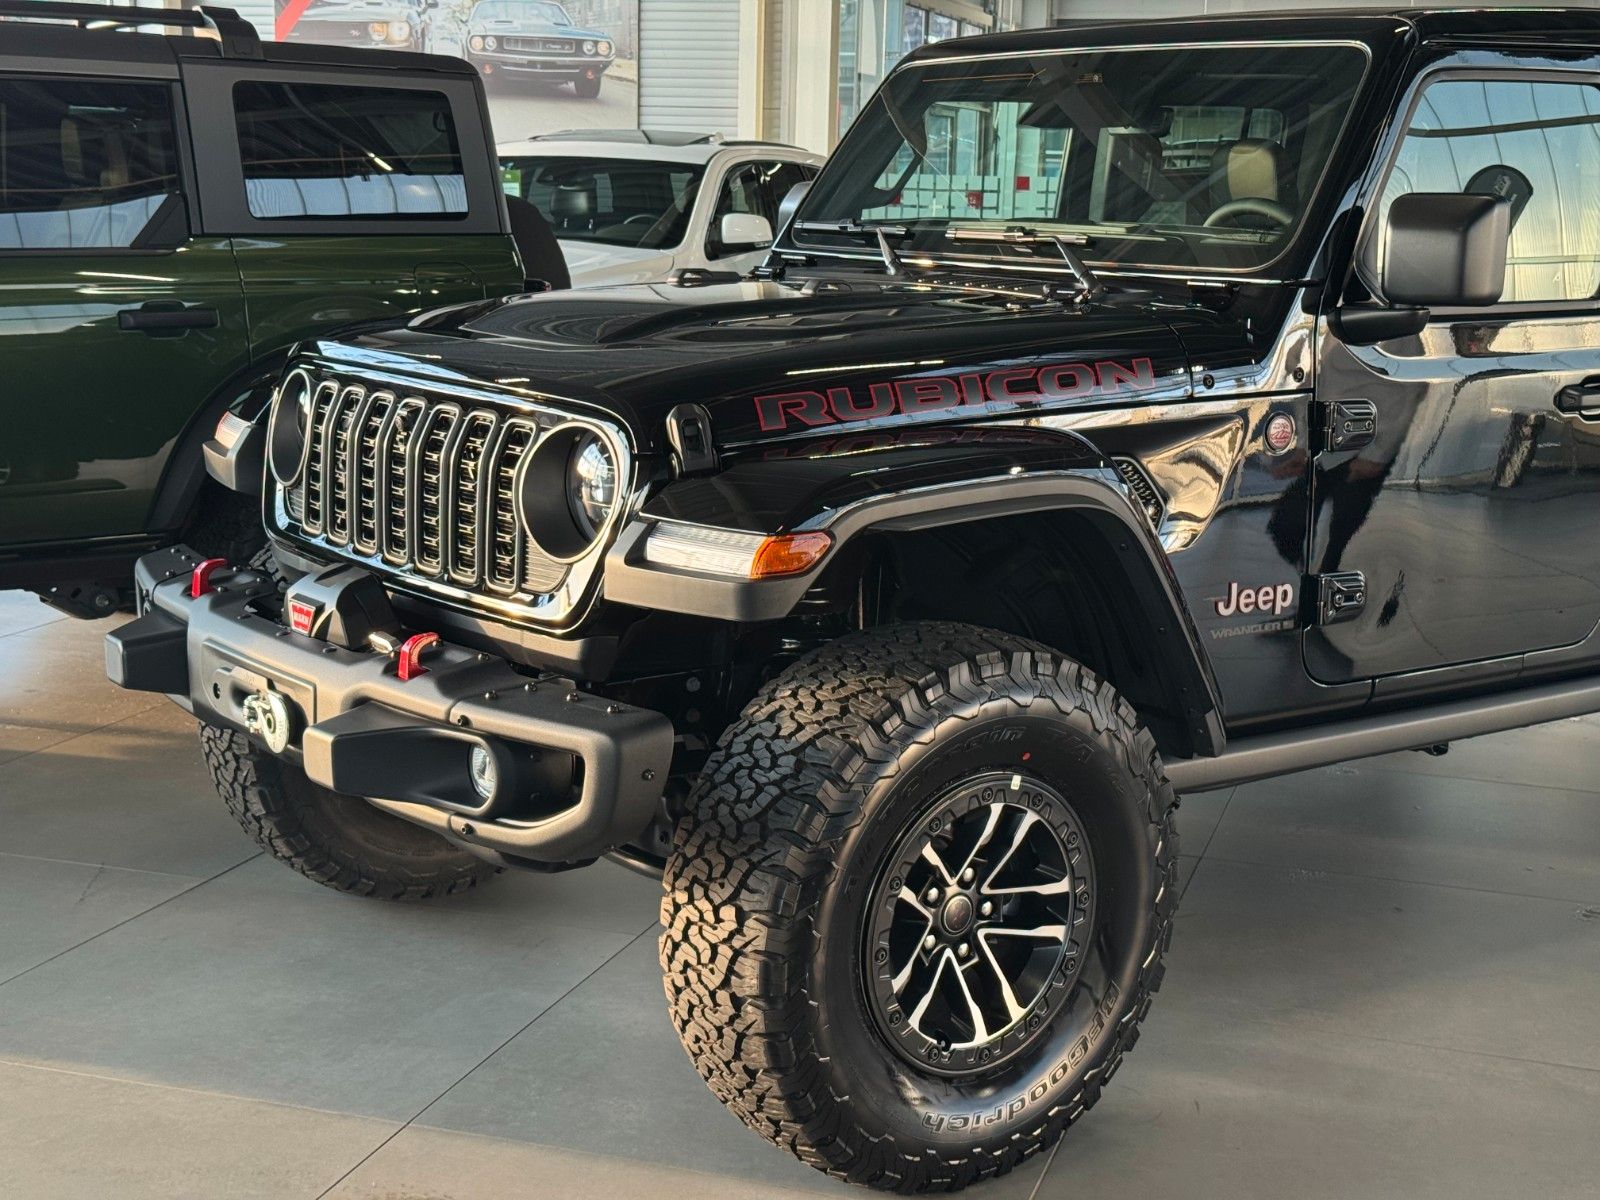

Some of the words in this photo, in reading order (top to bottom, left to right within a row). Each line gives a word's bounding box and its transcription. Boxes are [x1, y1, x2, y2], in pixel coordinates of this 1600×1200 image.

[753, 357, 1156, 432] RUBICON
[1215, 581, 1293, 616] Jeep
[1210, 621, 1281, 640] WRANGLER
[921, 980, 1121, 1135] BFGoodrich
